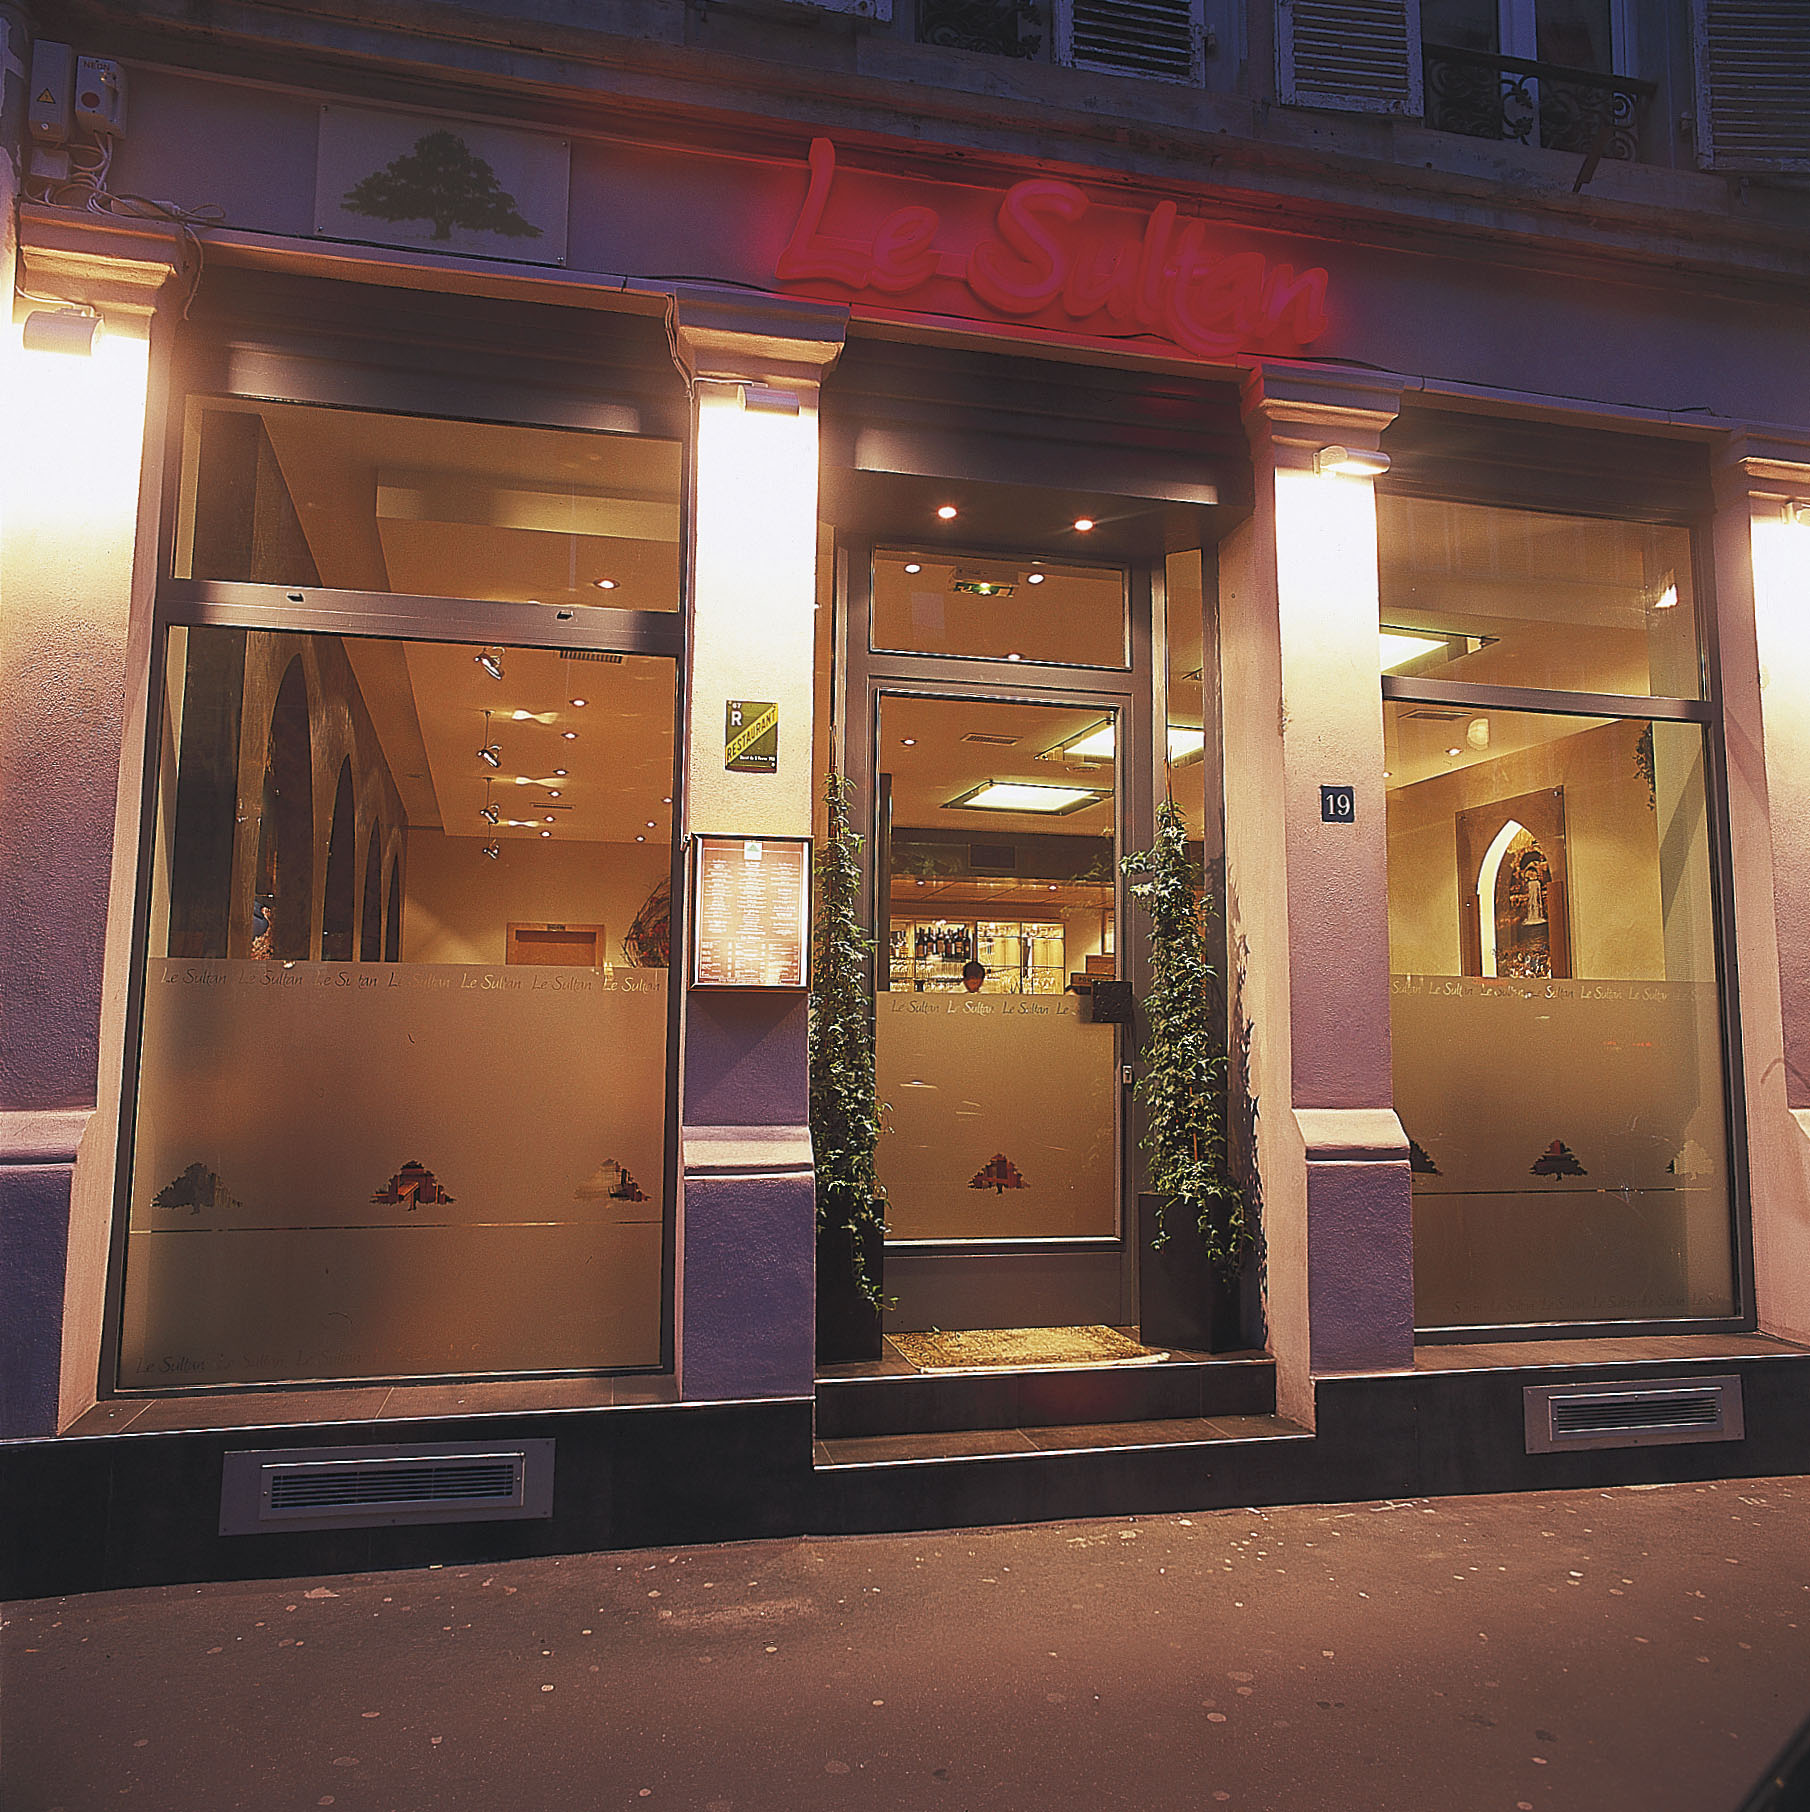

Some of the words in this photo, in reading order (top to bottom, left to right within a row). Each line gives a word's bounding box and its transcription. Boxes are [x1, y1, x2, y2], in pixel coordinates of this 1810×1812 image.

[775, 137, 940, 292] Le
[967, 179, 1329, 357] Sultan
[731, 711, 742, 726] R
[727, 709, 776, 761] RESTAURANT
[1326, 794, 1350, 815] 19
[160, 967, 179, 984] Le
[183, 968, 227, 987] Sultan
[239, 968, 257, 984] Le
[259, 969, 303, 988] Sultan
[461, 972, 478, 989] Le
[531, 975, 549, 990] Le
[552, 975, 592, 992] Sultan
[602, 976, 618, 991] Le
[1429, 981, 1441, 995] Le
[1580, 986, 1592, 998] Le
